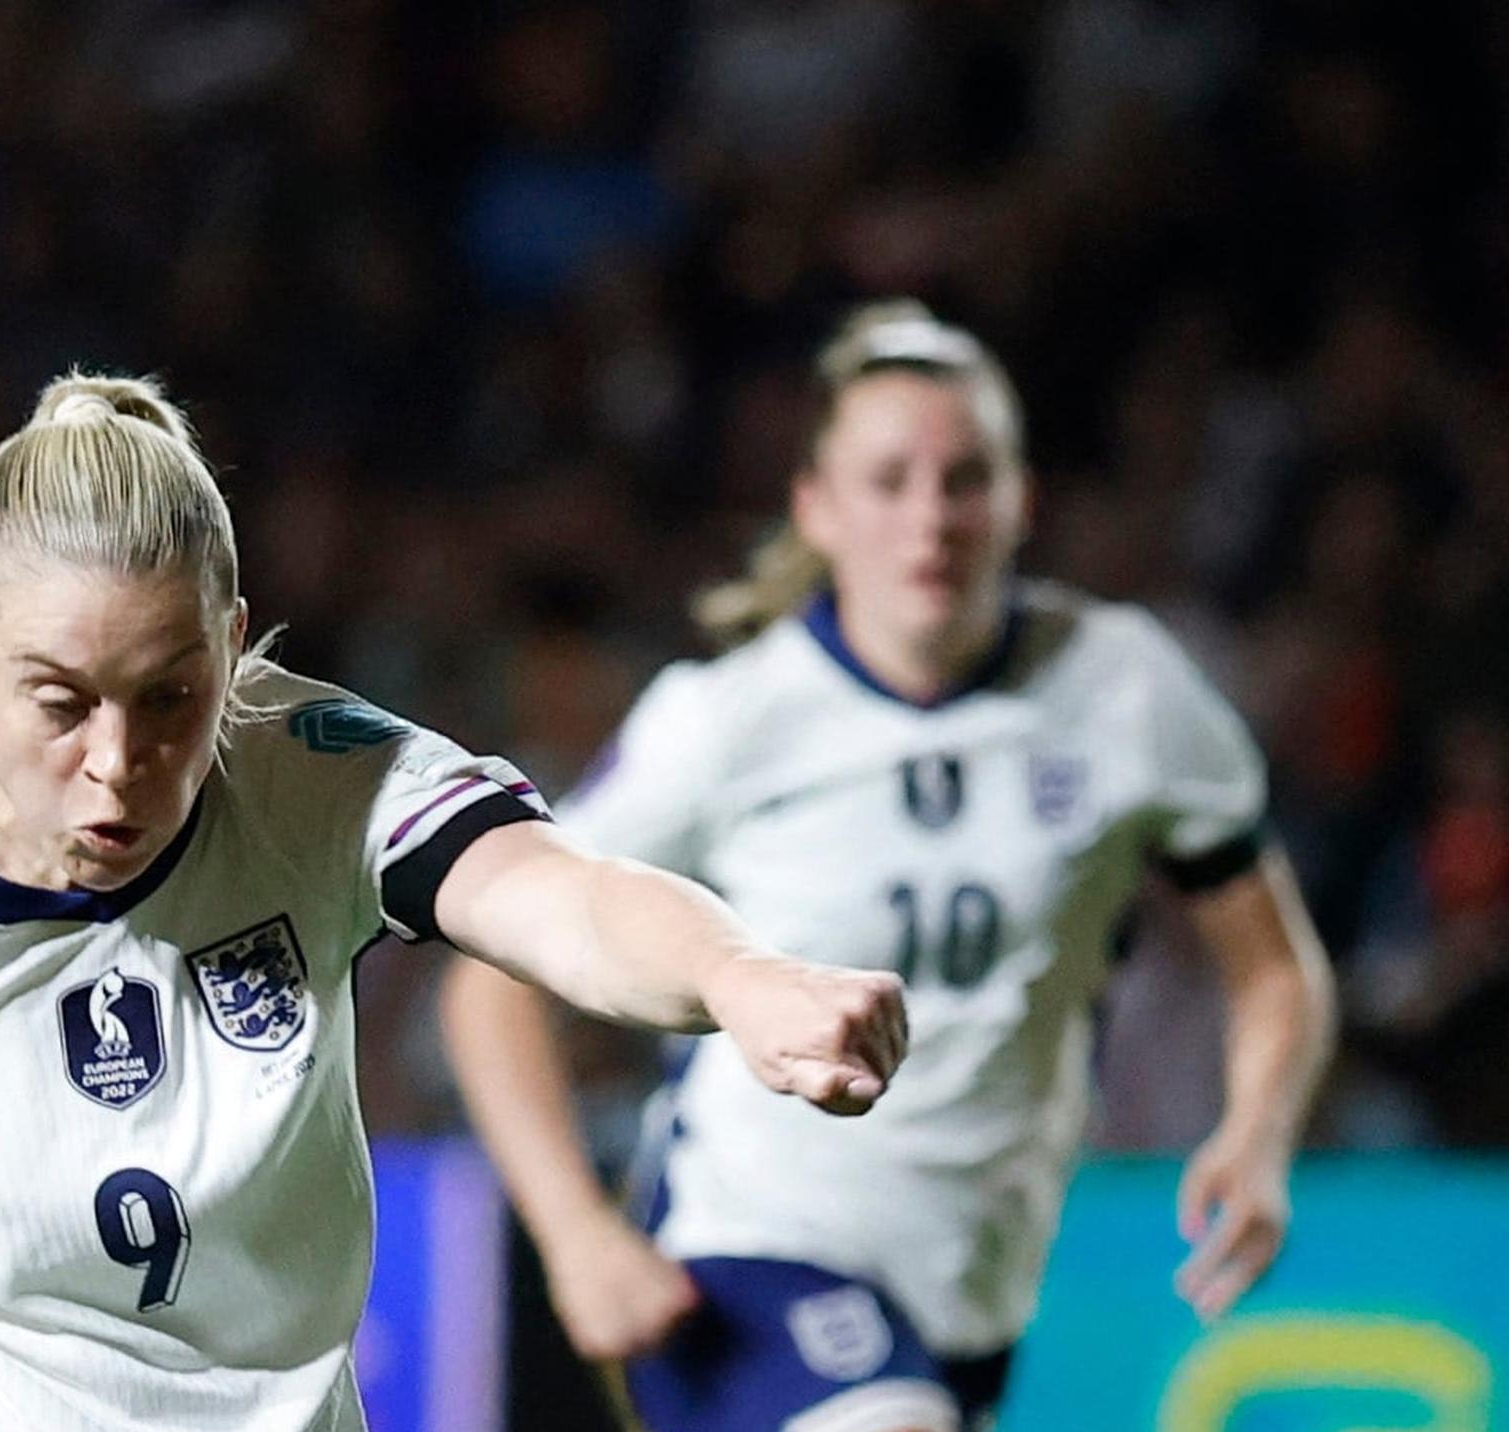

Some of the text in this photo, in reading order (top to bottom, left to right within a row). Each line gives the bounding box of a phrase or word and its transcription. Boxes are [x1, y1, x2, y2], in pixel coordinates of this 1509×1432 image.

[885, 878, 1000, 992] 10
[83, 1056, 145, 1075] EUROPEAN
[82, 1068, 149, 1087] CHAMPIONS
[101, 1082, 135, 1099] 2022
[94, 1167, 191, 1314] 9
